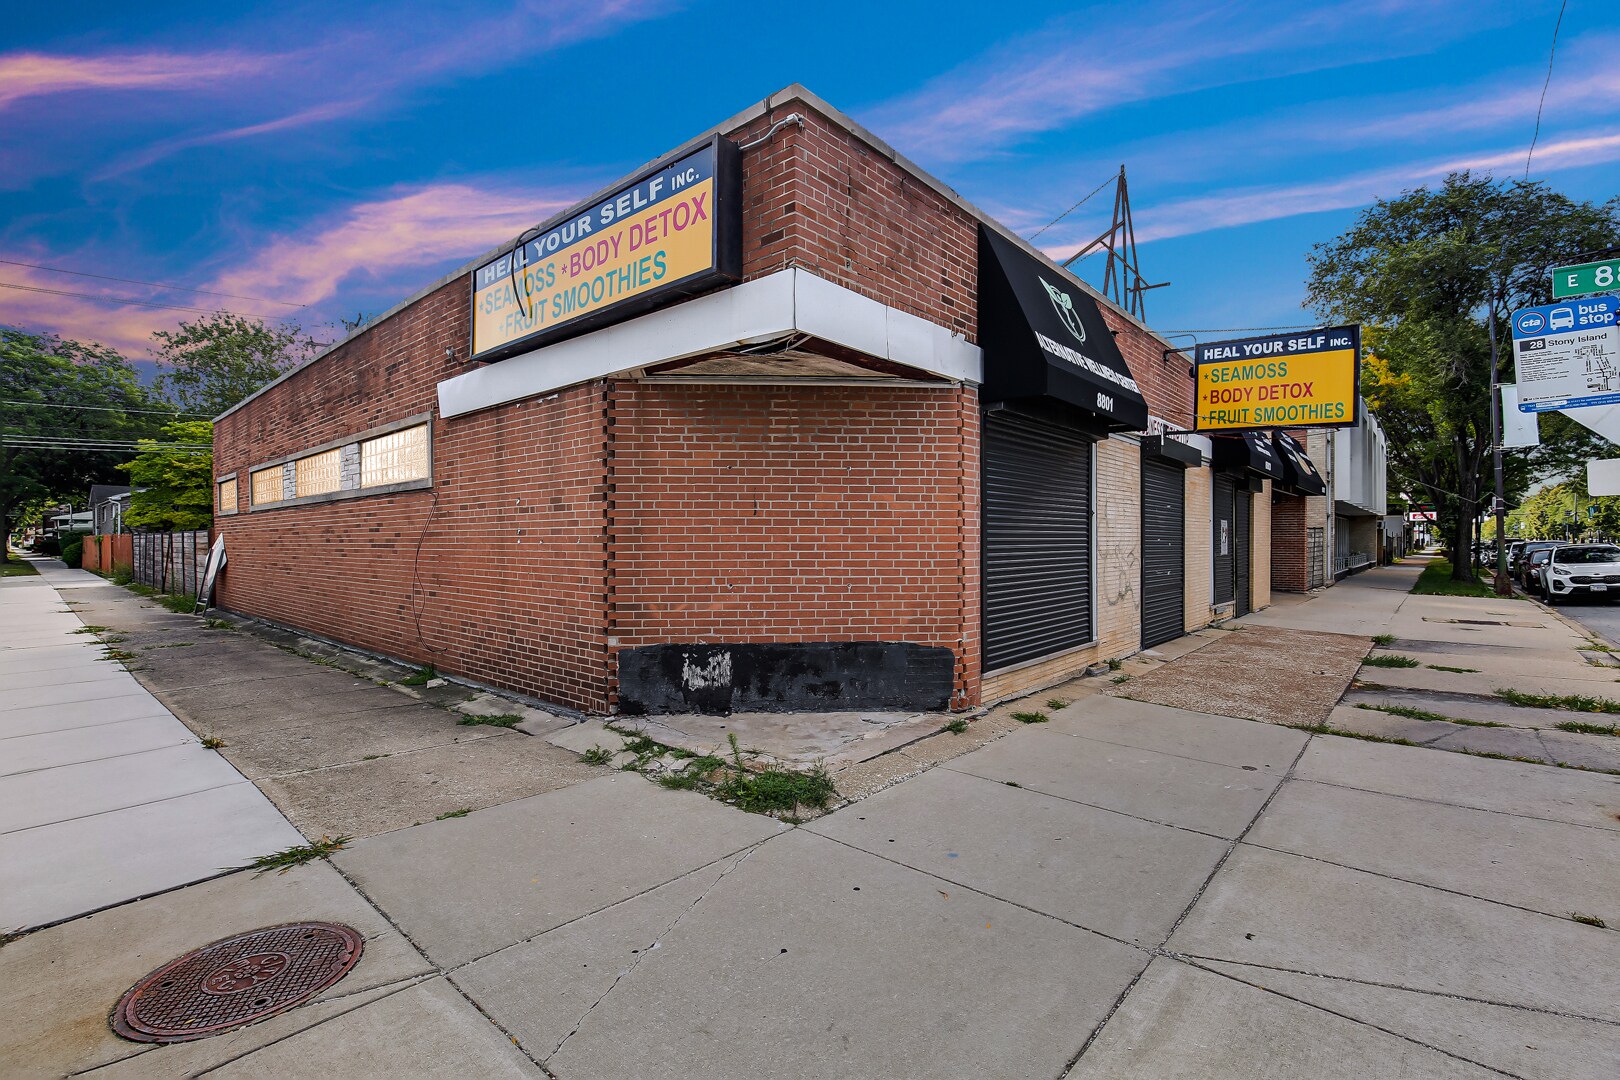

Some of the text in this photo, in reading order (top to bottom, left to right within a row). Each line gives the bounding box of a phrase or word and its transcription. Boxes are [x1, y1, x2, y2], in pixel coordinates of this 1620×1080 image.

[485, 167, 700, 284] HEAL YOUR SELF INC.
[485, 191, 707, 315] SEAMOSS BODY DETOX
[1567, 265, 1620, 288] E 8
[506, 250, 667, 337] FRUIT SMOOTHIES
[1578, 303, 1608, 315] bus
[1579, 312, 1614, 325] stop
[1521, 319, 1541, 328] cta
[1204, 336, 1352, 360] HEAL YOUR SELF INC.
[1529, 332, 1607, 350] 28 Stony Island
[1210, 361, 1288, 384] SEAMOSS
[1096, 392, 1114, 413] 8801
[1210, 382, 1314, 405] BODY DETOX
[1209, 402, 1345, 425] FRUIT SMOOTHIES
